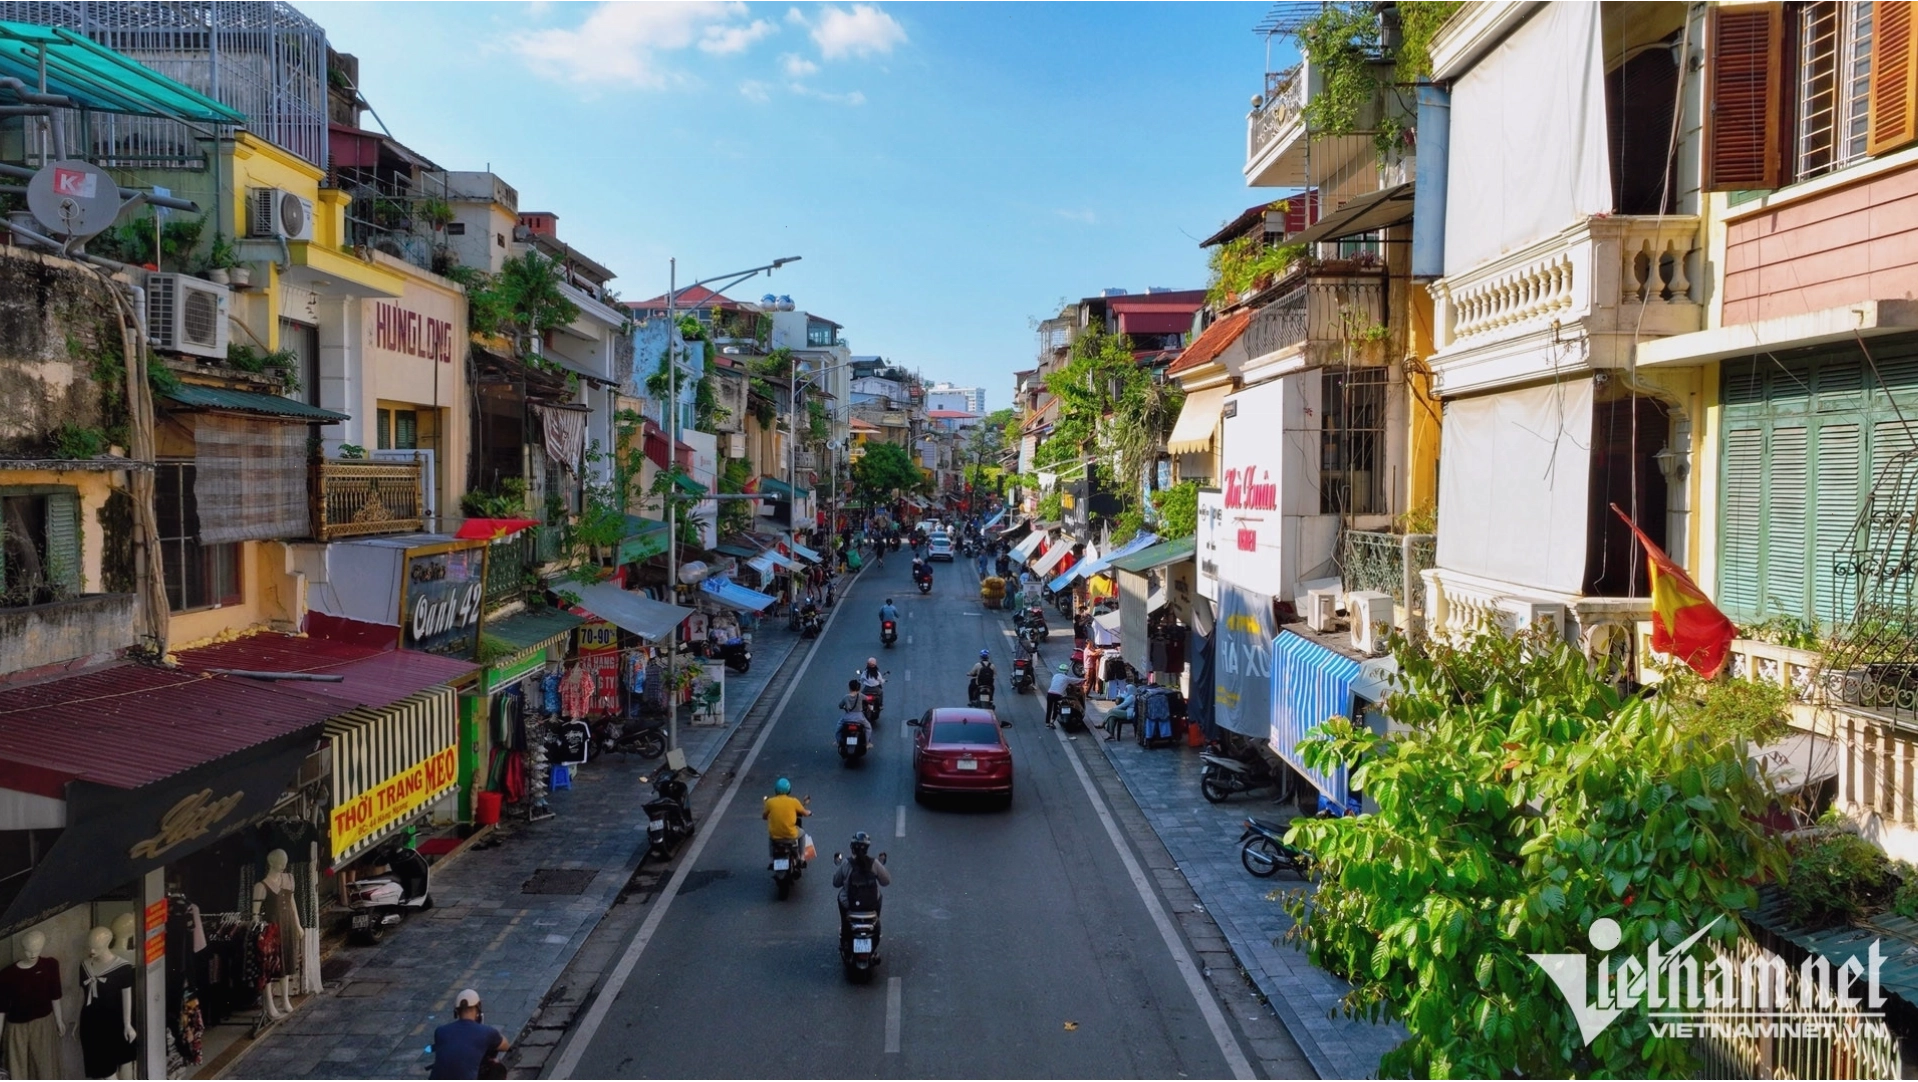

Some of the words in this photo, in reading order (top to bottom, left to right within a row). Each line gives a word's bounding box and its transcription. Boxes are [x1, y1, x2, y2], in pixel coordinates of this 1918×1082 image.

[413, 588, 457, 641] Oanh
[460, 583, 482, 628] 42
[335, 795, 373, 837] THỜI
[377, 770, 422, 811] TRANG
[424, 748, 455, 795] MEO
